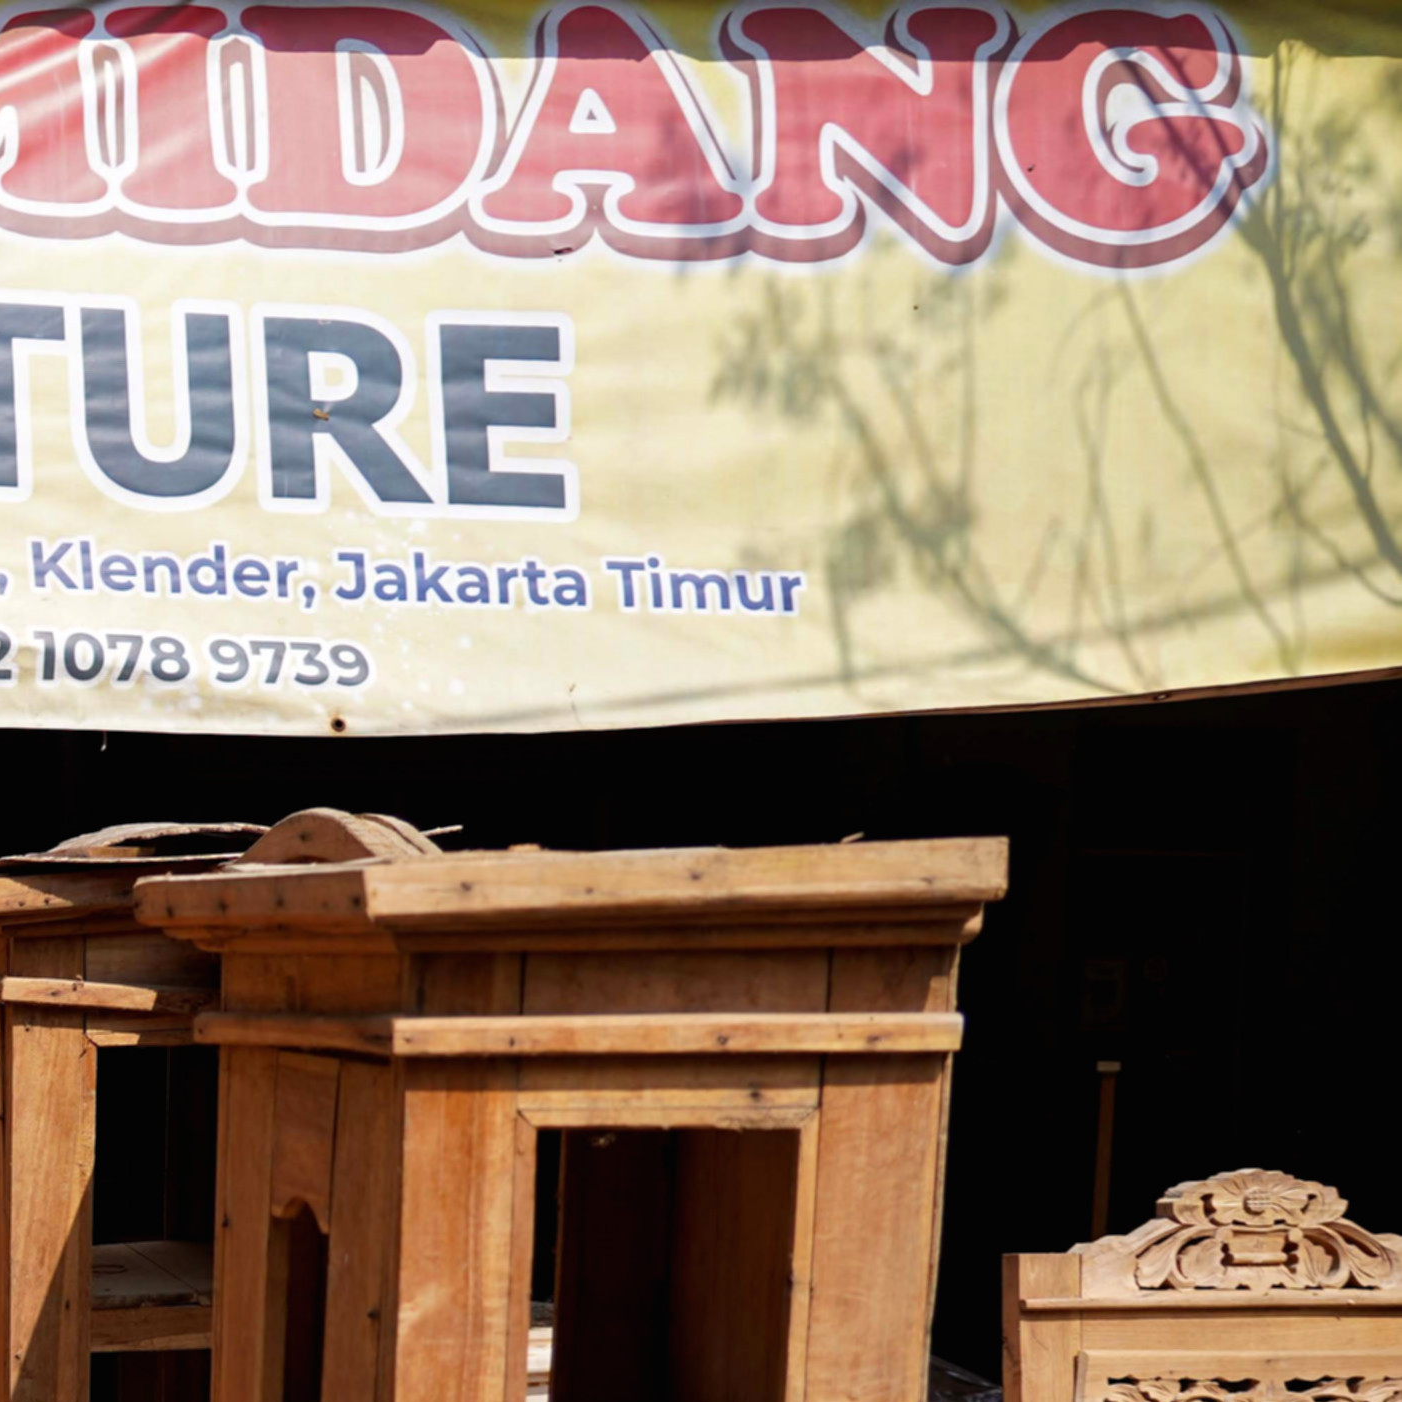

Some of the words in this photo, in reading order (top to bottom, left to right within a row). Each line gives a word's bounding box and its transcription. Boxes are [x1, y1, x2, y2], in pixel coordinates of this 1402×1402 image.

[33, 540, 315, 610] Klender,
[334, 551, 587, 607] Jakarta
[606, 557, 803, 612] Timur
[34, 630, 192, 683] 1078
[207, 638, 372, 687] 9739
